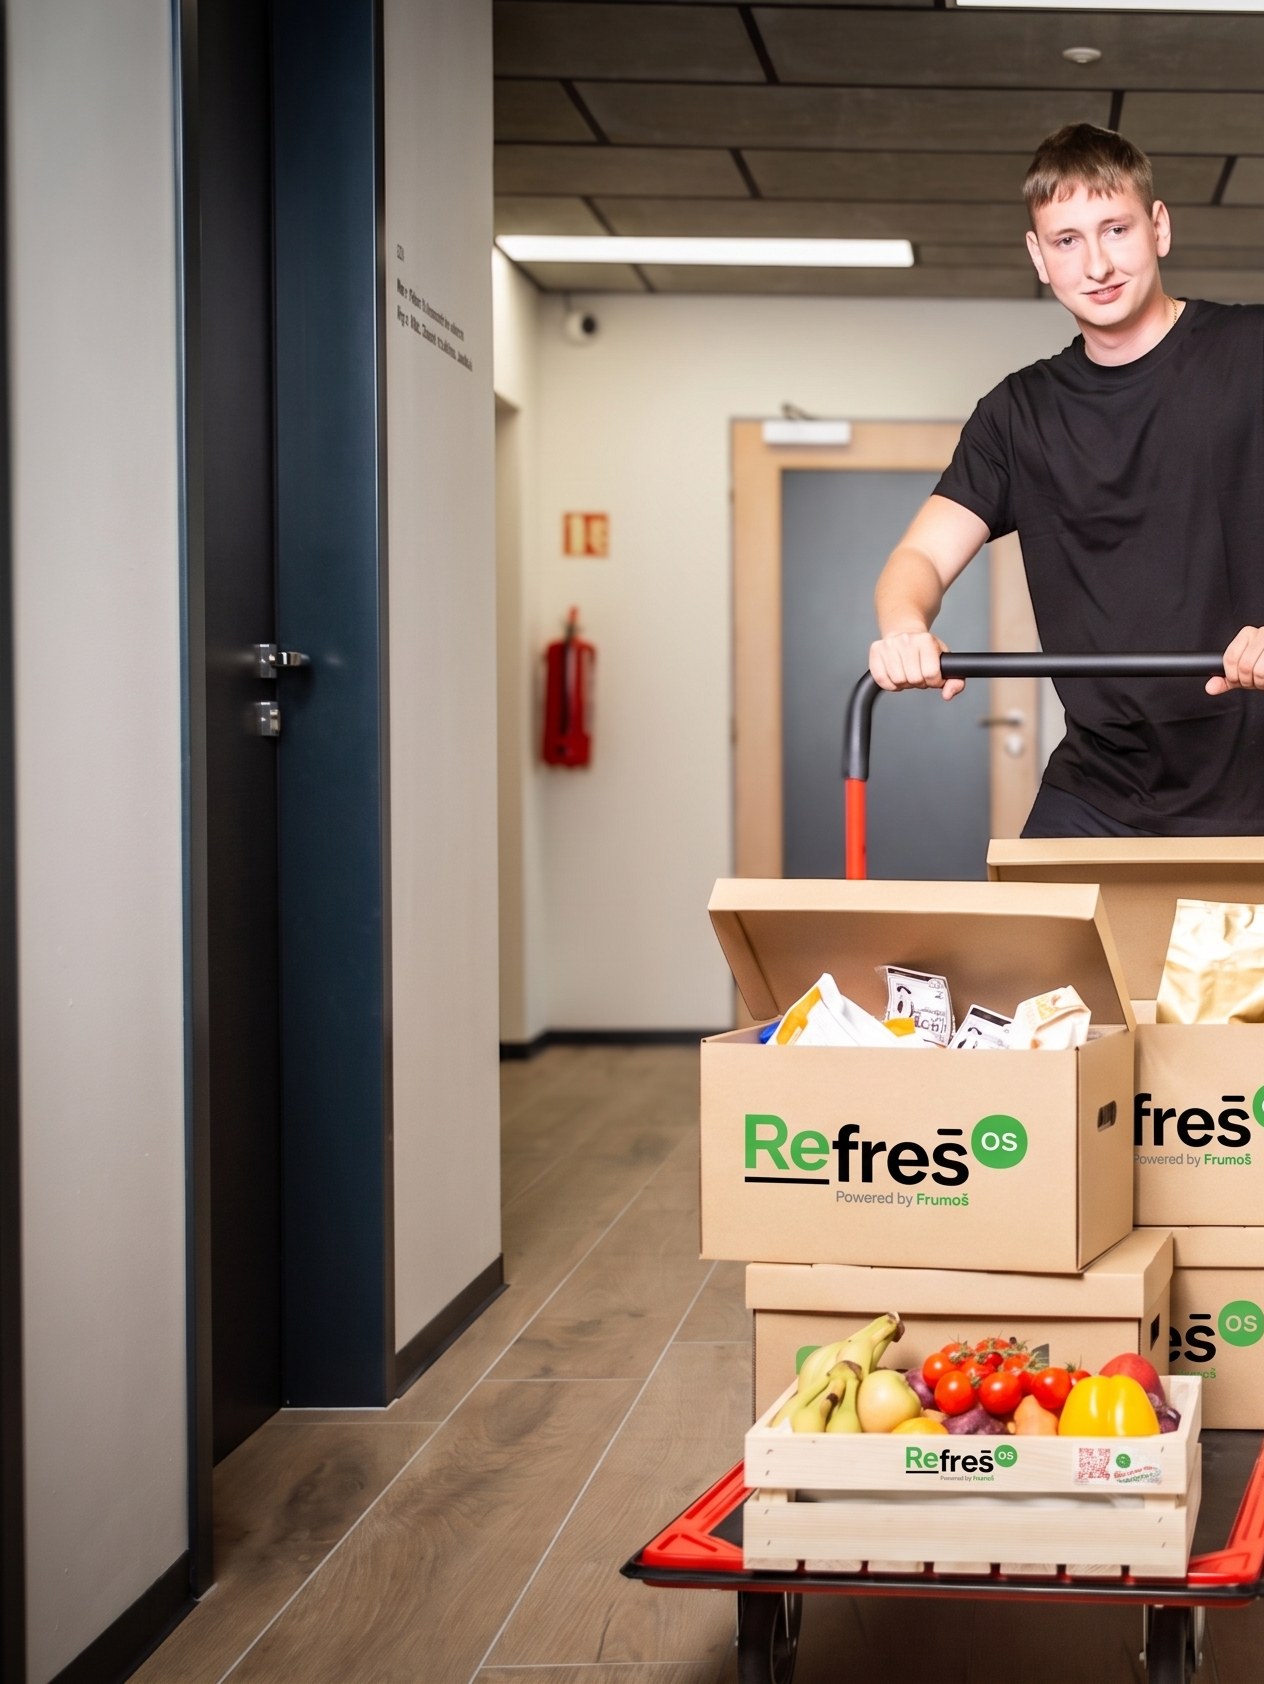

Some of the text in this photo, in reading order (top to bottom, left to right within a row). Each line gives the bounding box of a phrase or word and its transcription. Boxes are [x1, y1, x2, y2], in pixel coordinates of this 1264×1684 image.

[981, 1131, 1018, 1152] OS
[1186, 1154, 1201, 1167] by
[836, 1190, 970, 1207] Powered by Frumoš
[1225, 1315, 1258, 1333] OS
[998, 1451, 1014, 1460] OS
